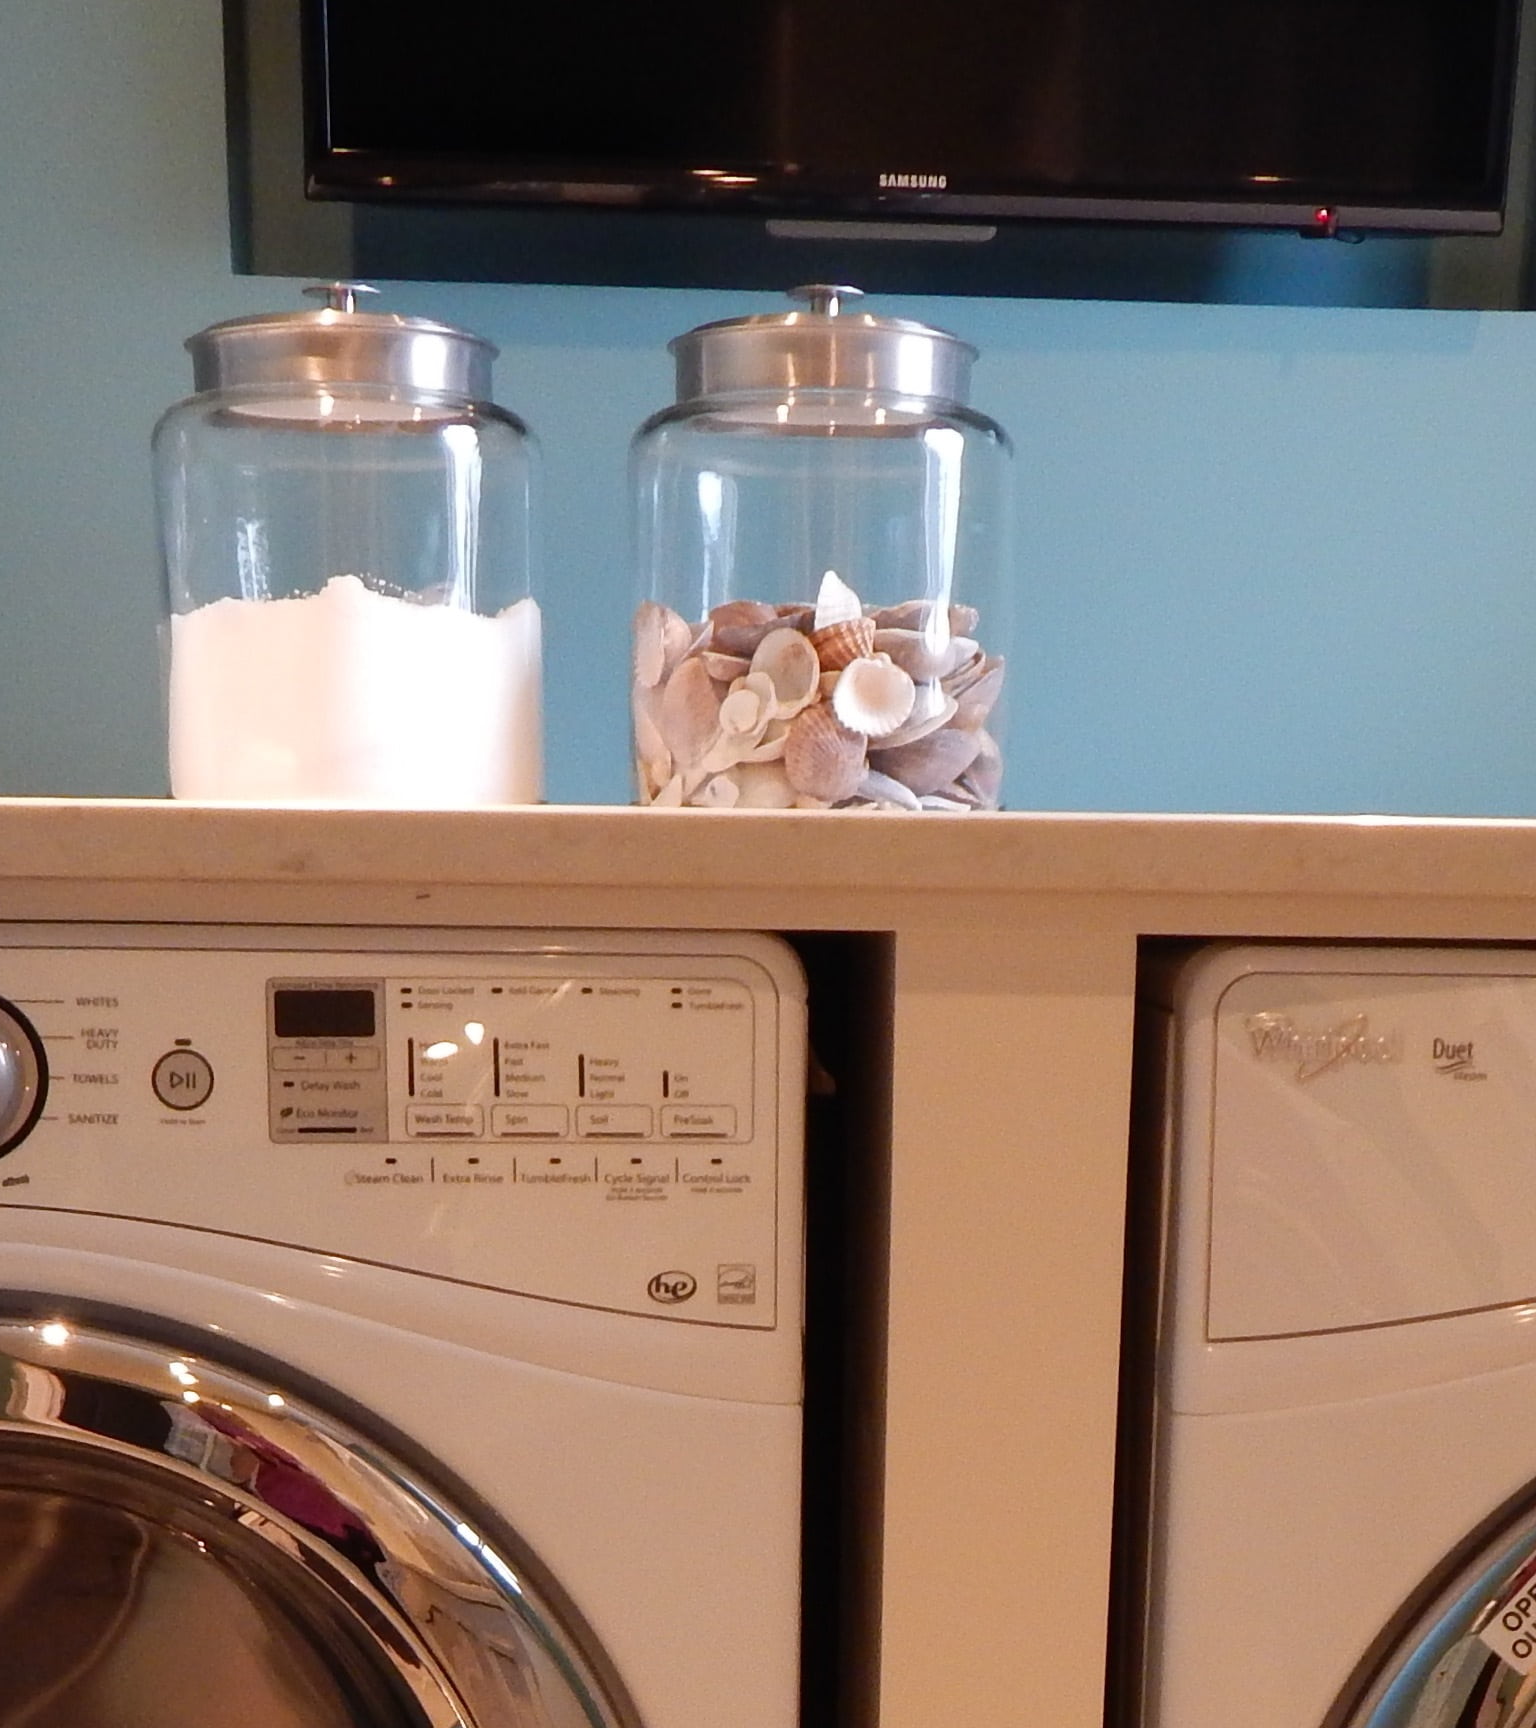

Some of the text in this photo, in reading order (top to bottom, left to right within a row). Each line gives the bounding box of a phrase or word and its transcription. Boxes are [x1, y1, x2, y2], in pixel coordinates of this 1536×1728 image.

[878, 173, 948, 189] SAMSUNG
[76, 996, 119, 1008] WHITES
[80, 1028, 120, 1038] HEAVY
[86, 1038, 119, 1050] DUTY
[1432, 1037, 1474, 1060] Duet
[72, 1073, 119, 1085] TOWELS
[68, 1113, 119, 1125] SANITIZE
[442, 1173, 505, 1184] Extra Rinse
[603, 1173, 671, 1186] Cycle Signal
[682, 1172, 752, 1184] Control Lock
[653, 1273, 690, 1300] he
